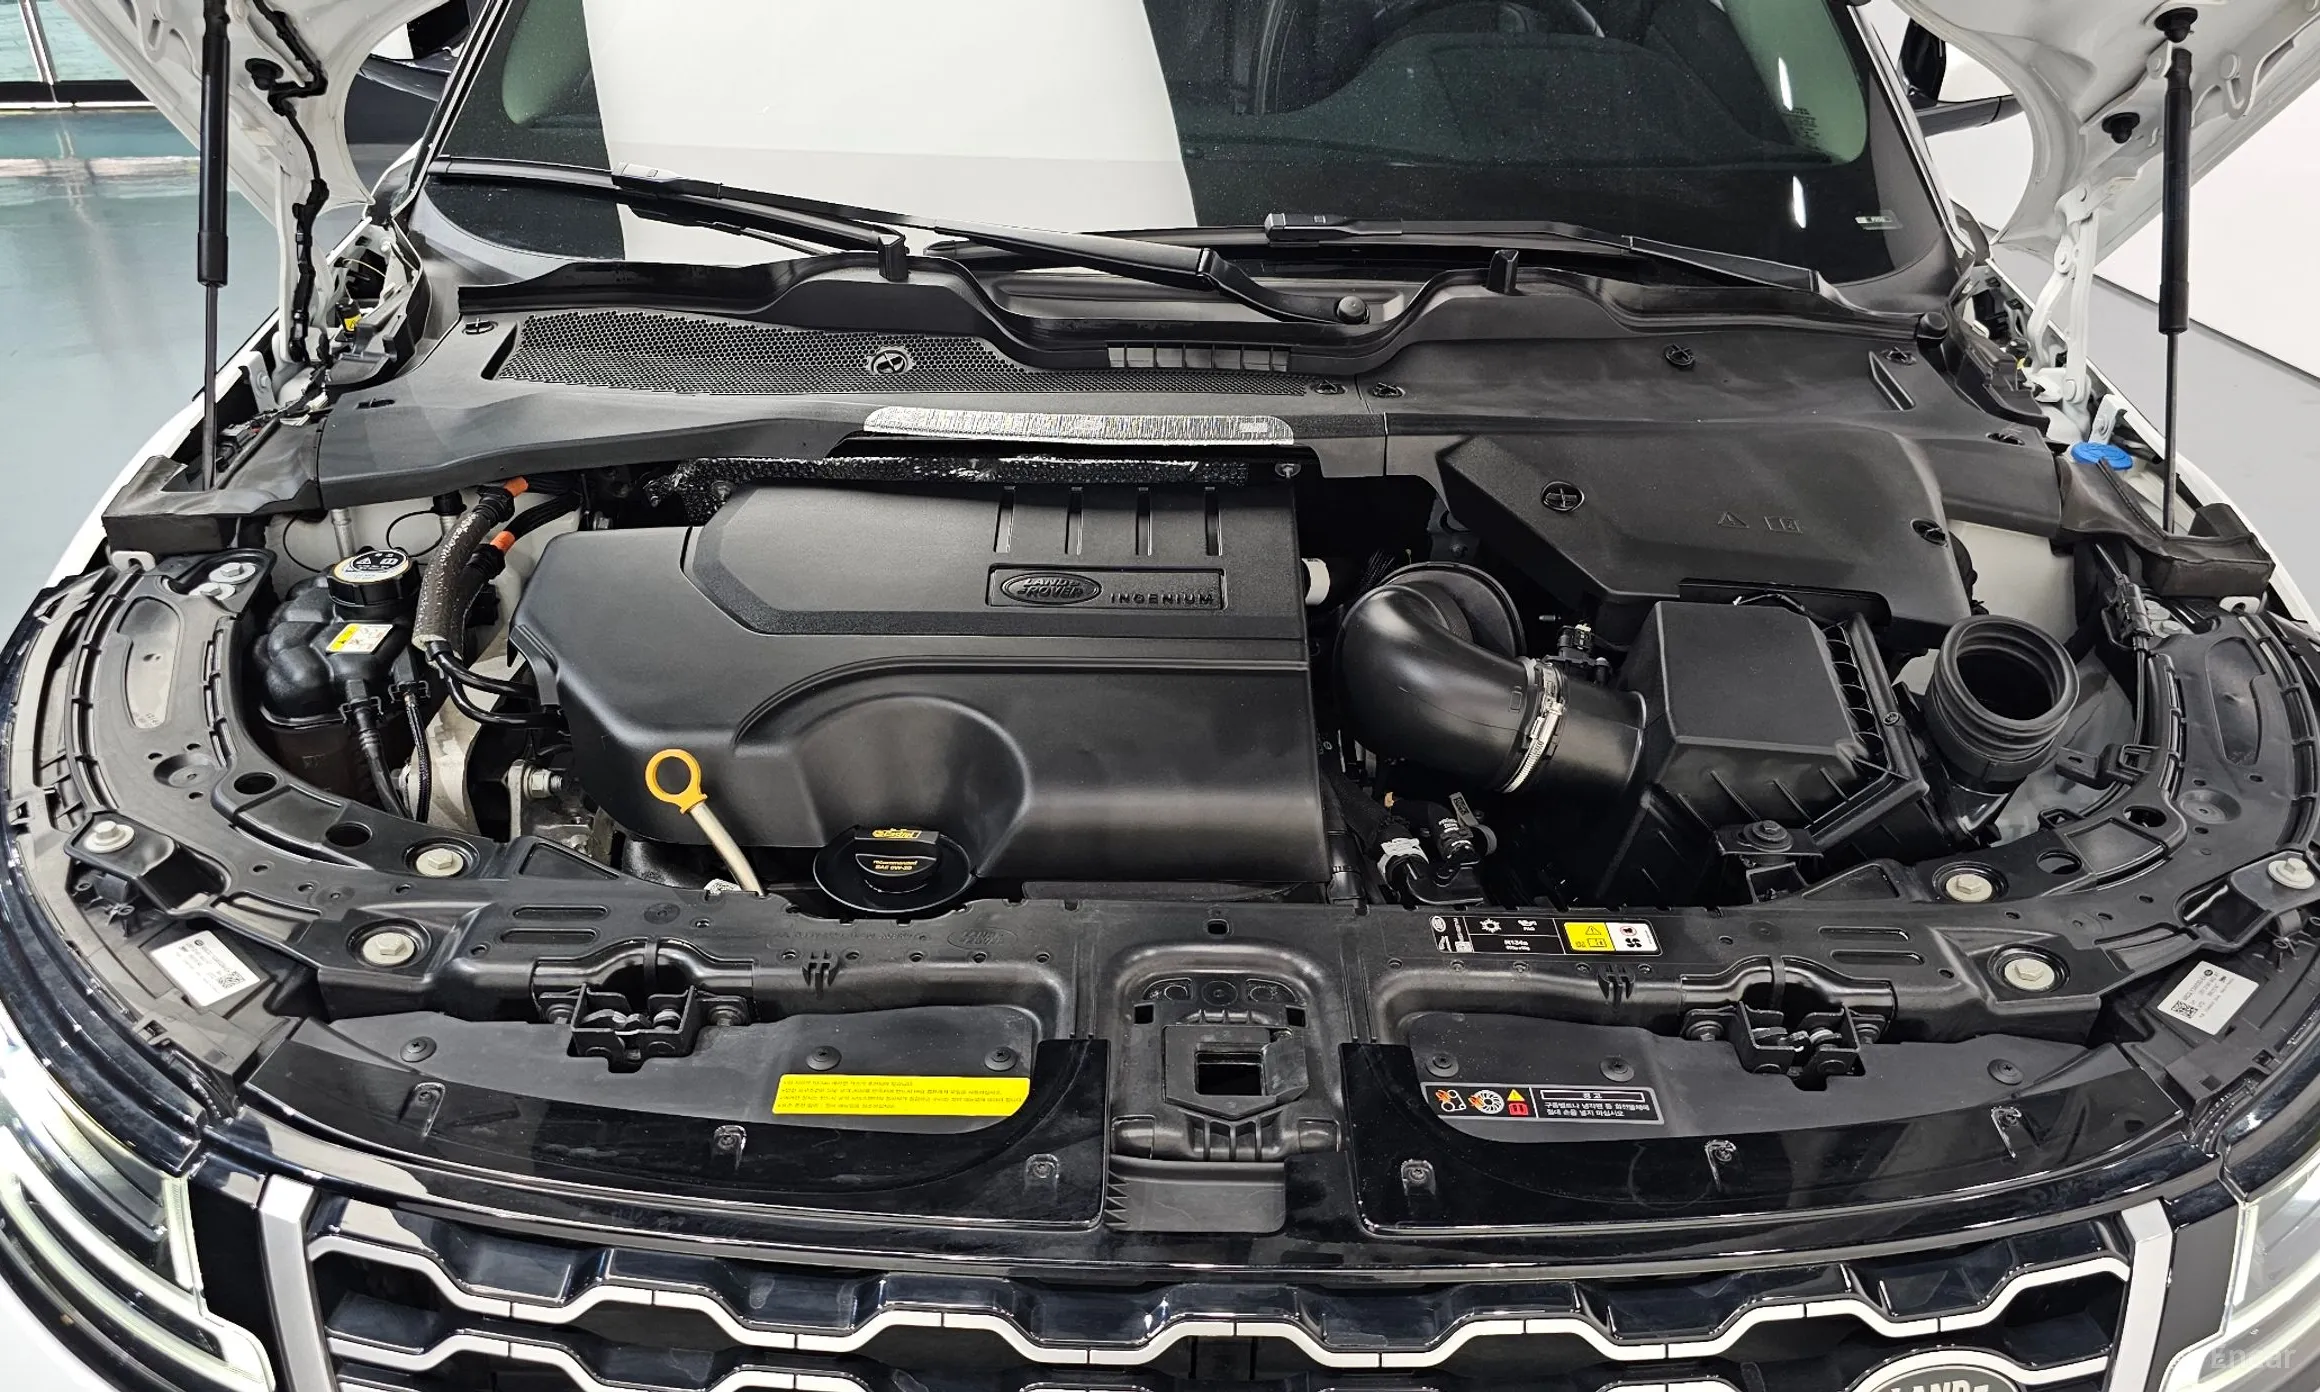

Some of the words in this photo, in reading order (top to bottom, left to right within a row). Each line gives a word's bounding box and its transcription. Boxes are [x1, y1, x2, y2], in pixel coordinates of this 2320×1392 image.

[1023, 578, 1069, 587] LAND
[1025, 585, 1083, 598] ROVER
[1110, 593, 1213, 604] INGENIUM
